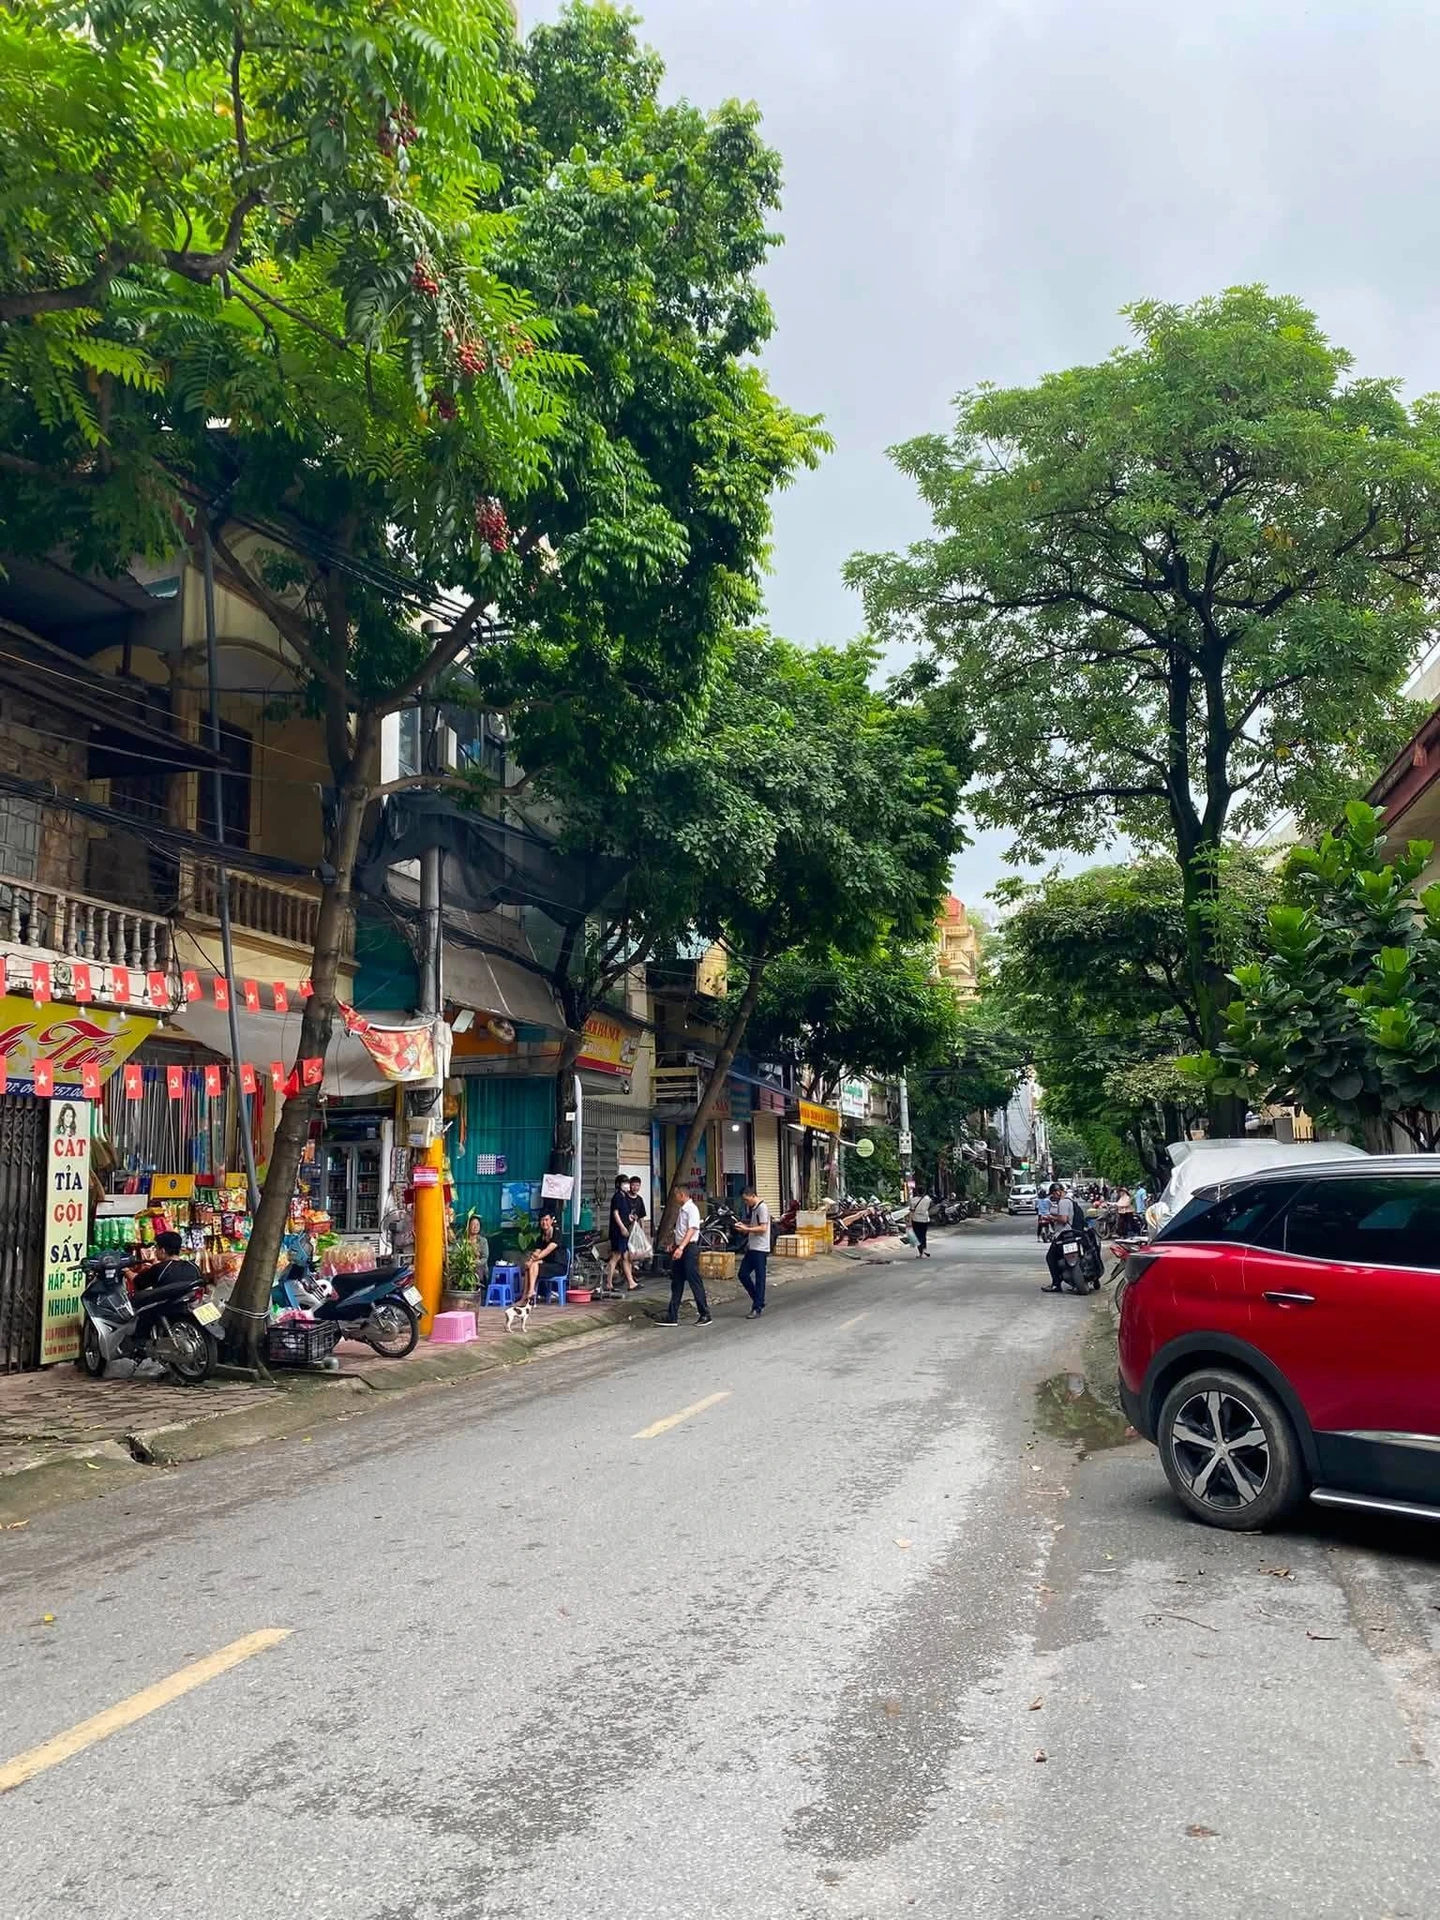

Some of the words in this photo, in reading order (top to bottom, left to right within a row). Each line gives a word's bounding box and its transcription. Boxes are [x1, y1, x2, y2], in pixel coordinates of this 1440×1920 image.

[55, 1164, 82, 1191] TỈA
[54, 1199, 83, 1227] GỘI
[50, 1235, 83, 1264] SẤY
[47, 1294, 79, 1318] NHUỘM
